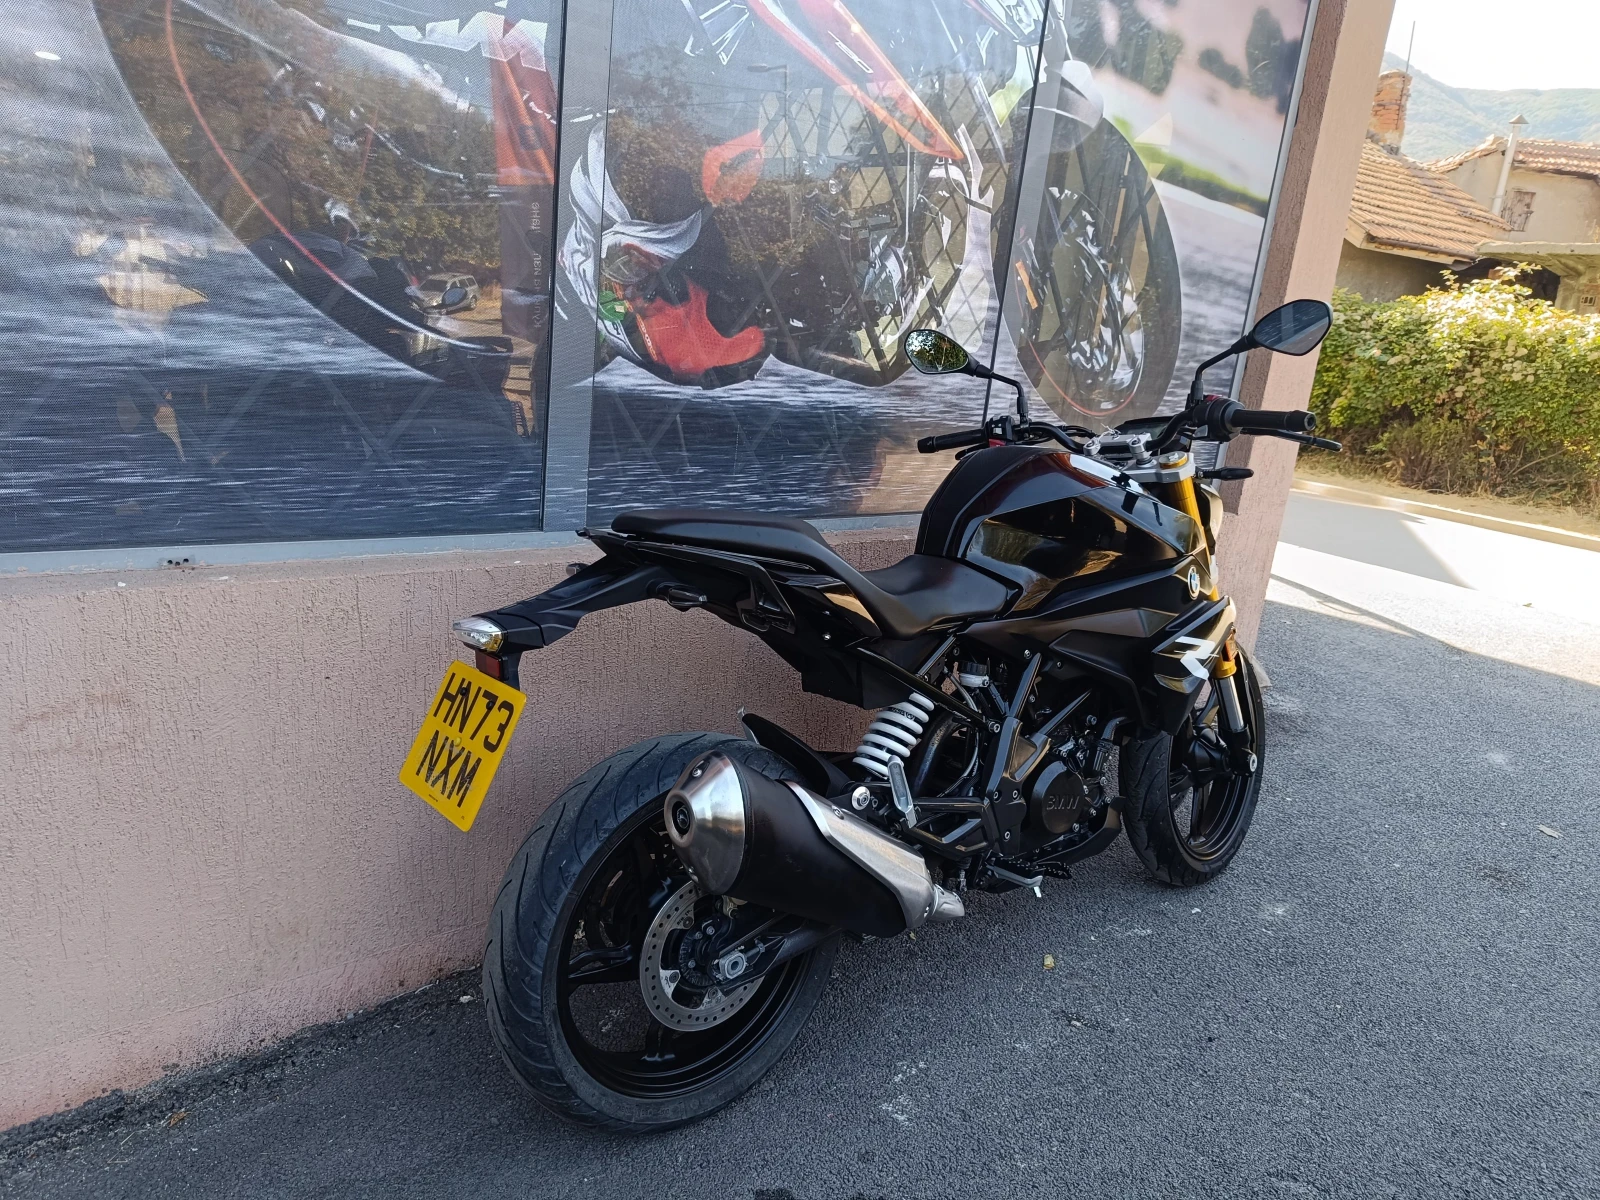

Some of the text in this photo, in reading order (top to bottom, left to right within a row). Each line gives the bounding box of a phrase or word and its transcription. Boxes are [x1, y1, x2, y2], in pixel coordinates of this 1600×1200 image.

[433, 672, 514, 753] HN73
[415, 730, 482, 808] NXM
[1046, 795, 1080, 810] BMW
